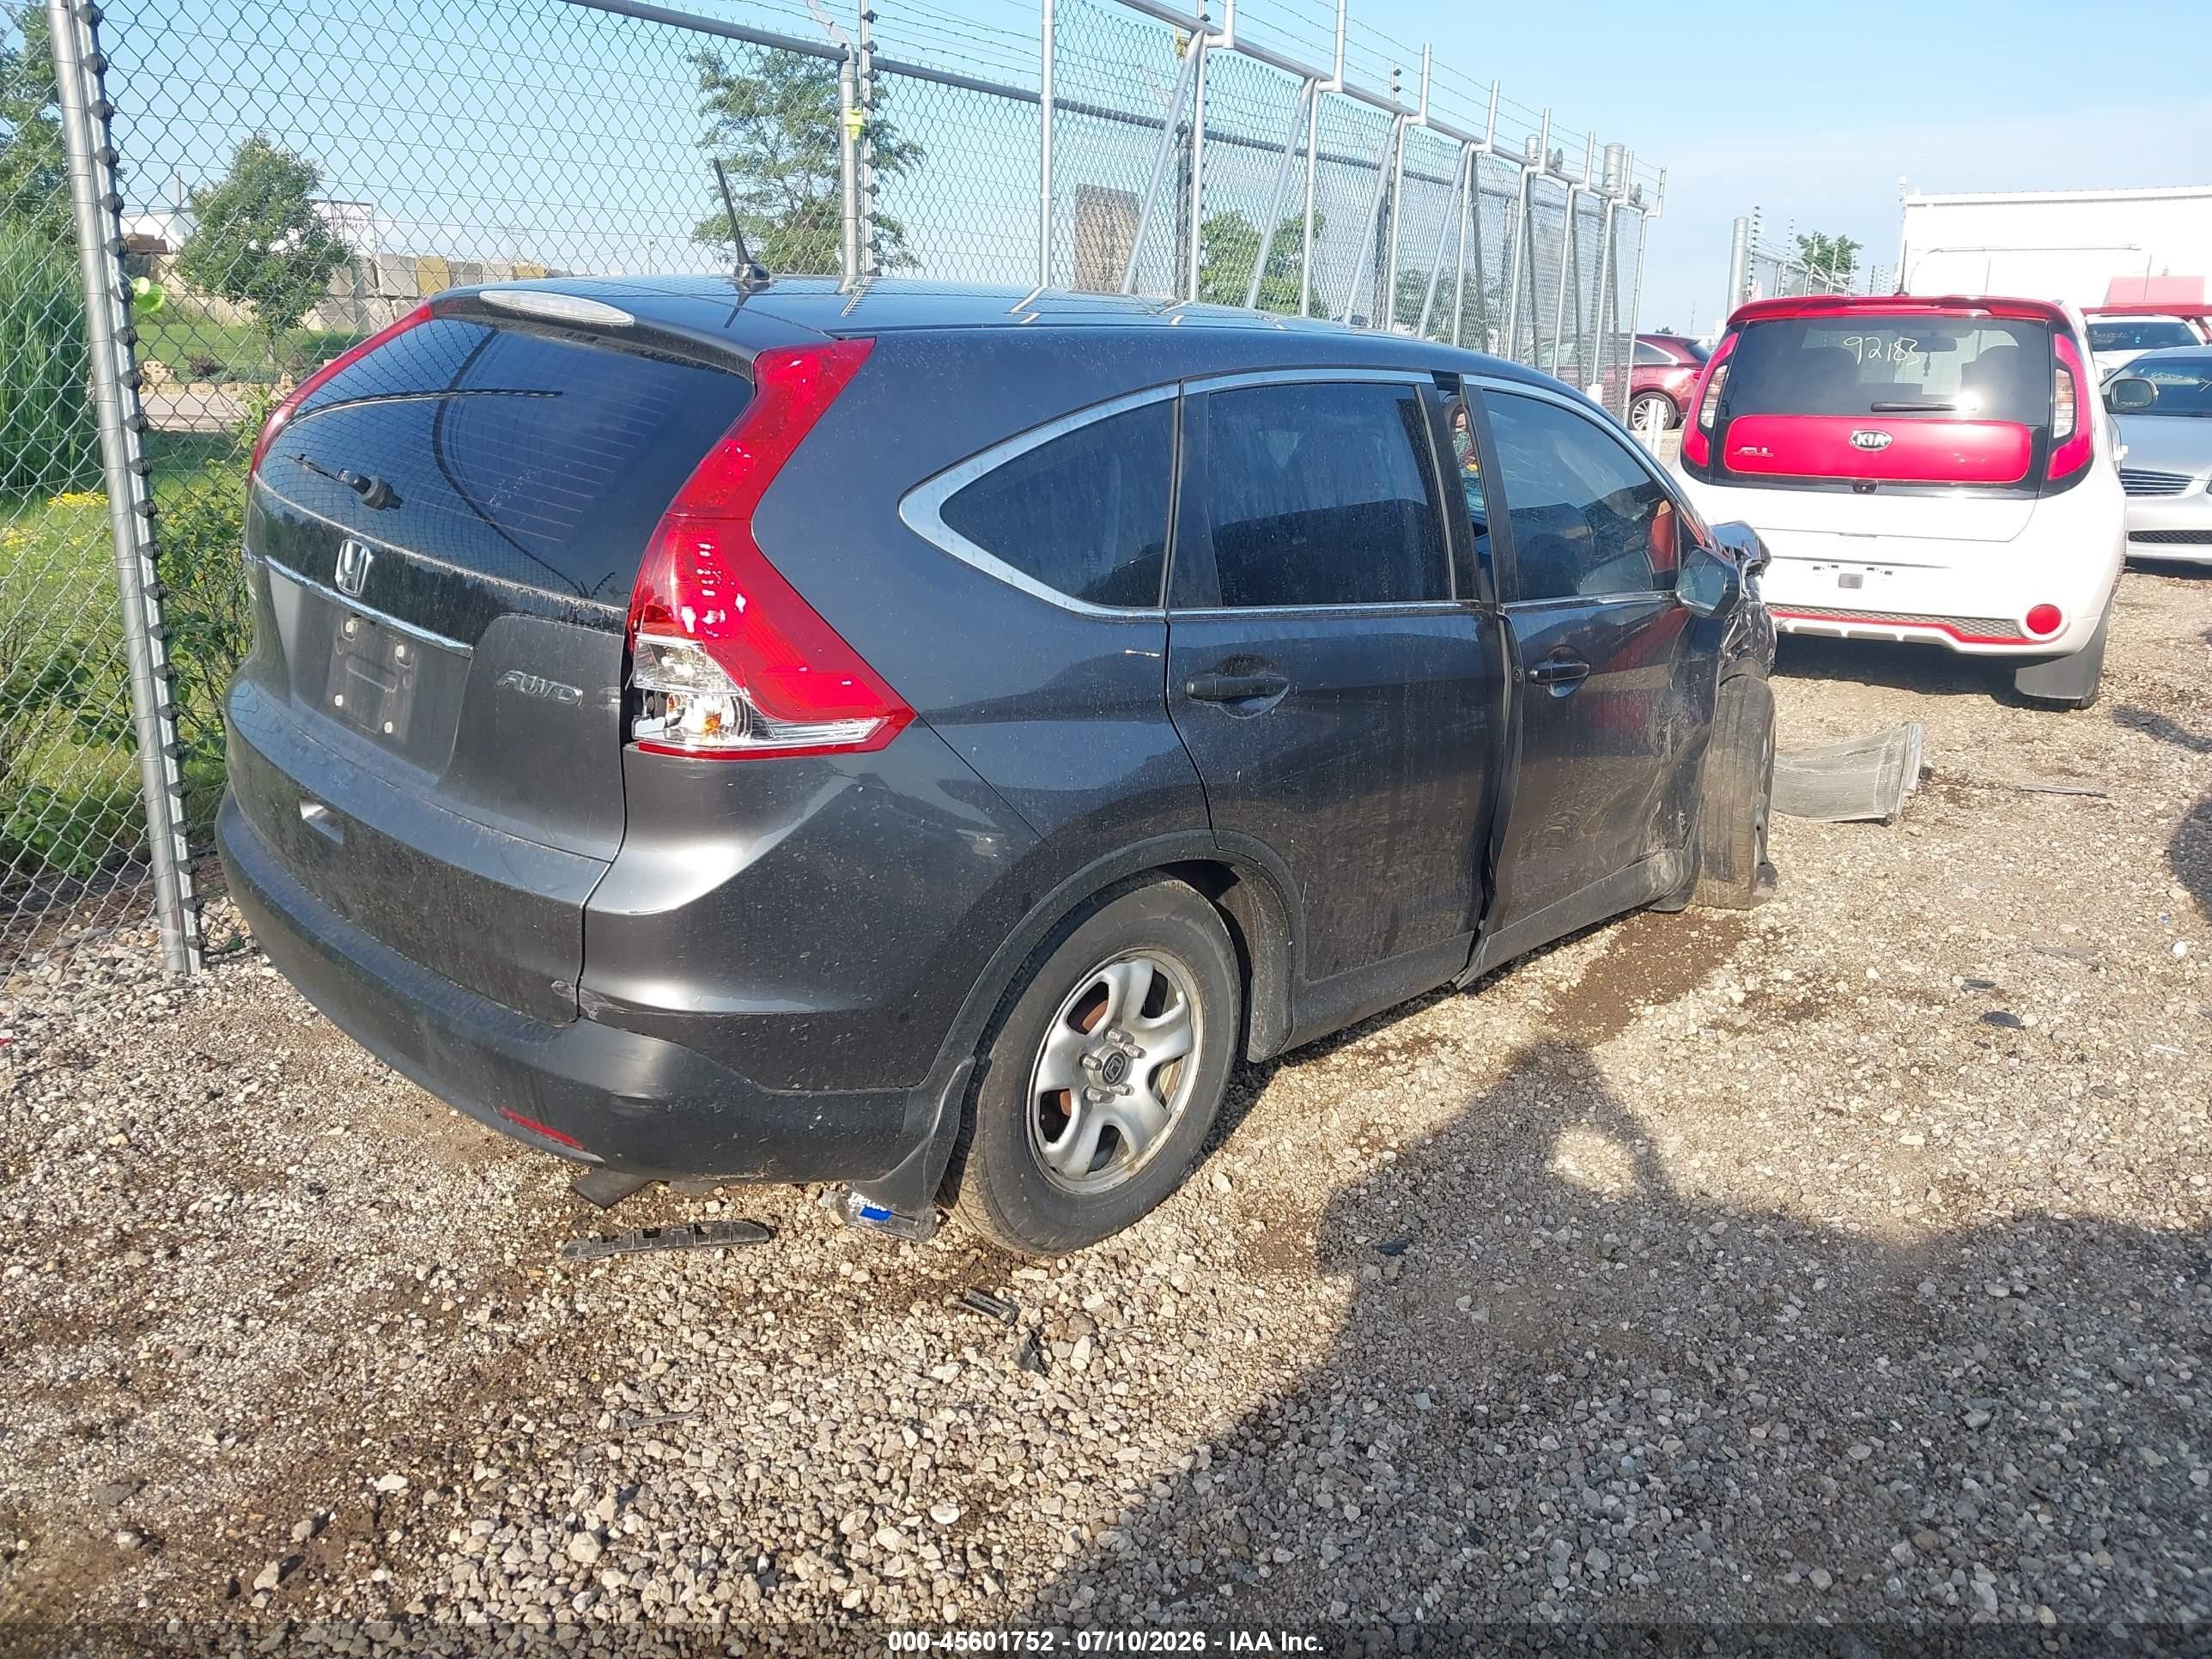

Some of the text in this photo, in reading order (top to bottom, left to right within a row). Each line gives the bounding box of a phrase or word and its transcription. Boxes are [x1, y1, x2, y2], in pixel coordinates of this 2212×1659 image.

[1844, 337, 1920, 366] 92183
[1854, 432, 1891, 447] KIA
[497, 670, 584, 707] AWD
